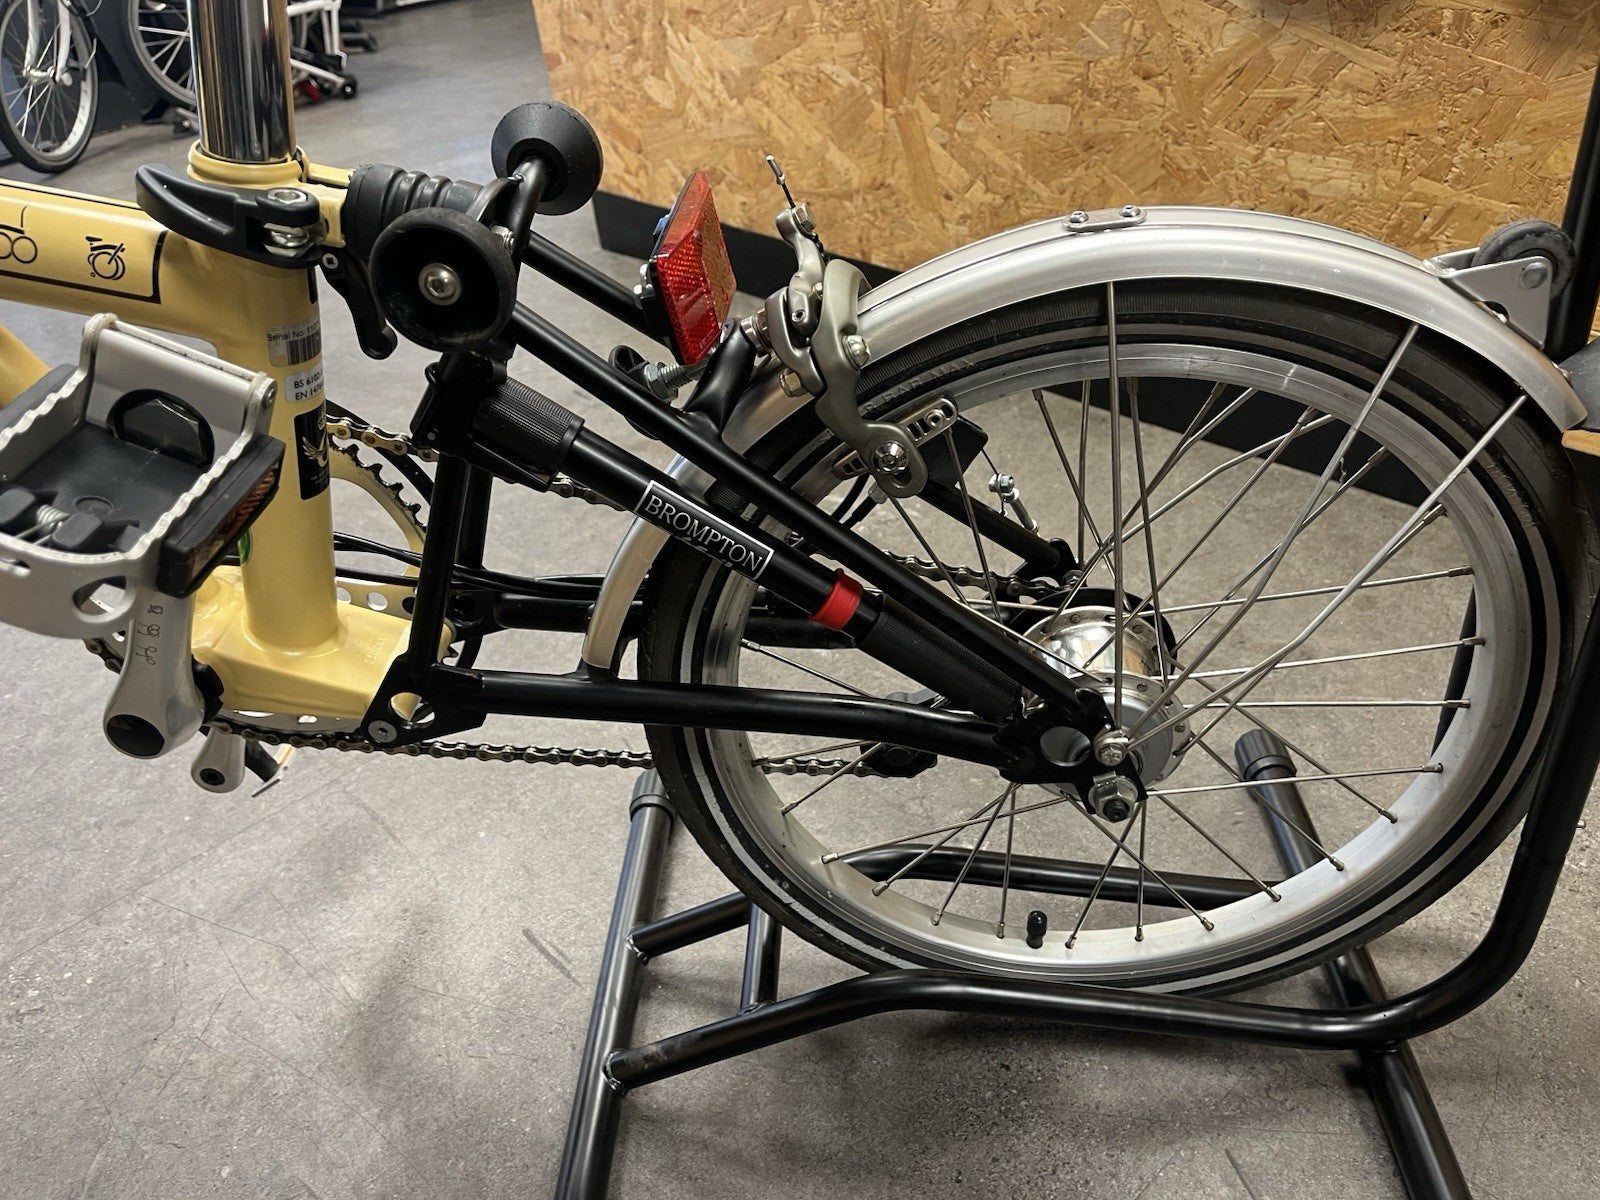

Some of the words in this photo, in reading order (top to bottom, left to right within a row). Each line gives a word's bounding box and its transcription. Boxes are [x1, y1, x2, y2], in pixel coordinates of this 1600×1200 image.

[294, 379, 304, 389] BS
[295, 390, 307, 400] EN
[645, 494, 763, 572] BROMPTON
